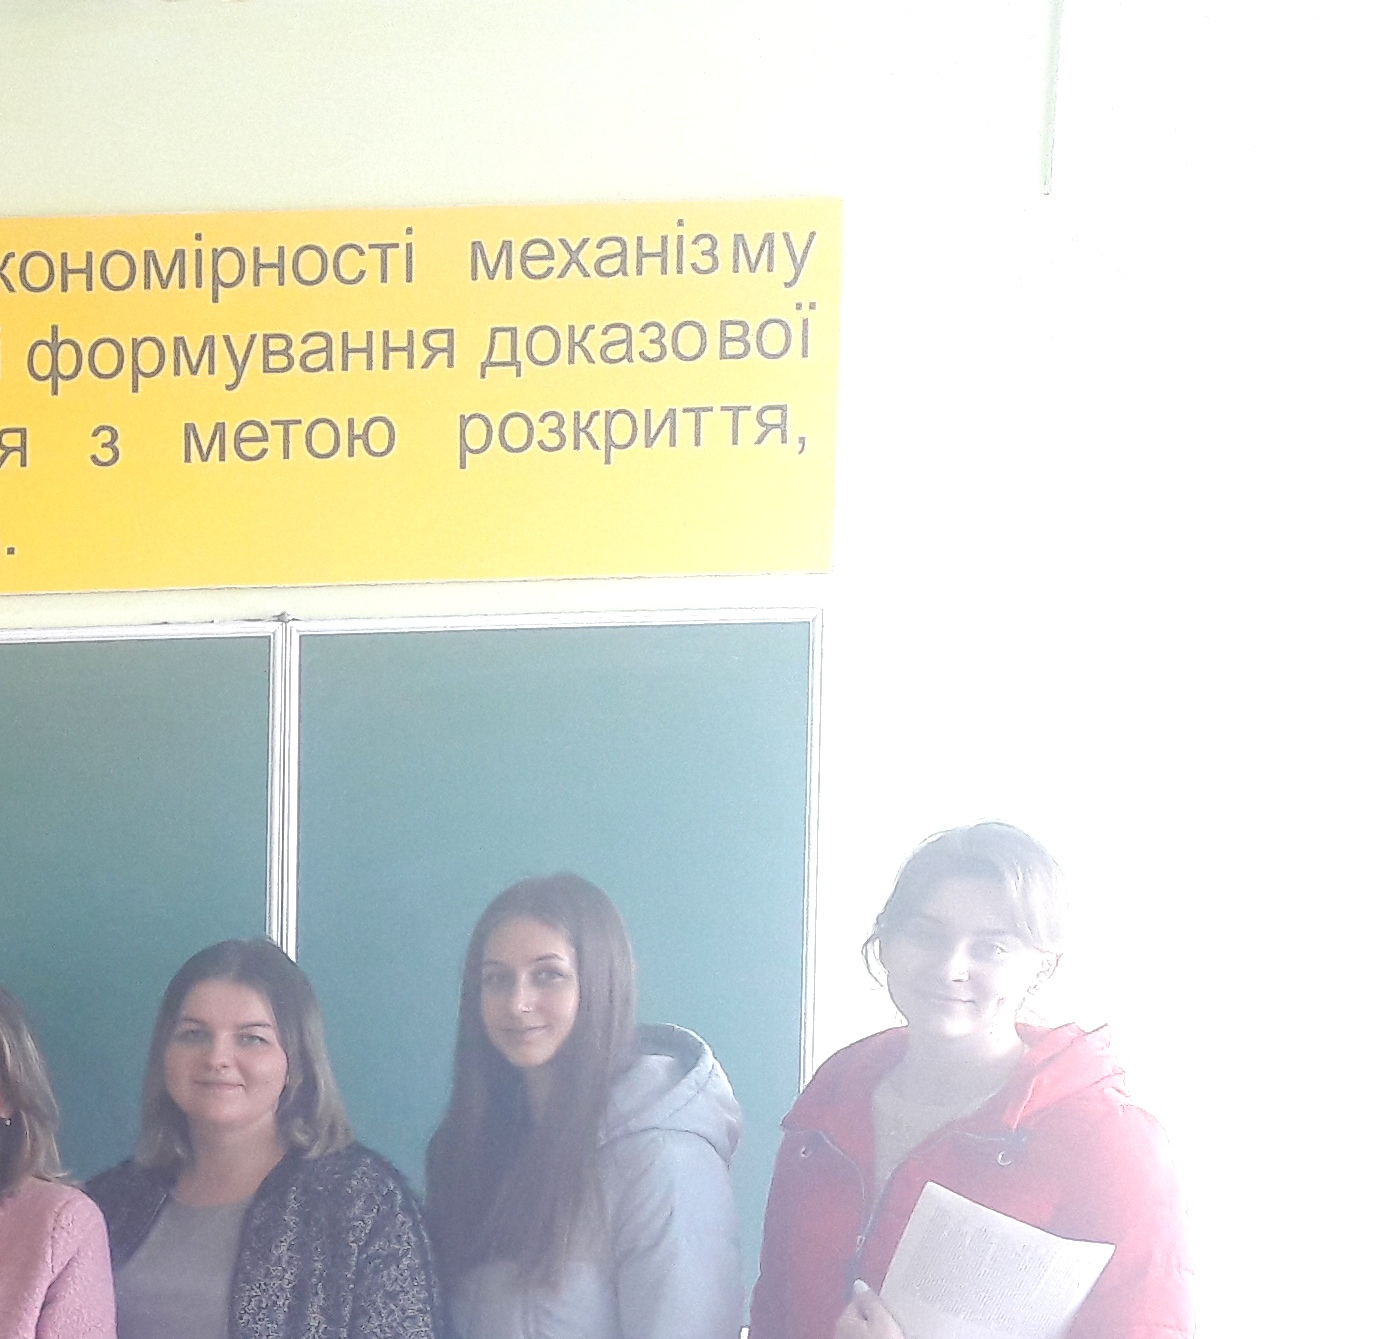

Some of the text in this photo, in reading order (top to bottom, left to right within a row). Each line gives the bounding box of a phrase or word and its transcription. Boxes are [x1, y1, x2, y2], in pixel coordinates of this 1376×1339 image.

[470, 218, 817, 289] механізму
[26, 323, 455, 397] формування
[479, 301, 817, 380] доказової
[89, 424, 120, 468] з
[183, 415, 396, 464] метою
[458, 403, 807, 470] розкриття,
